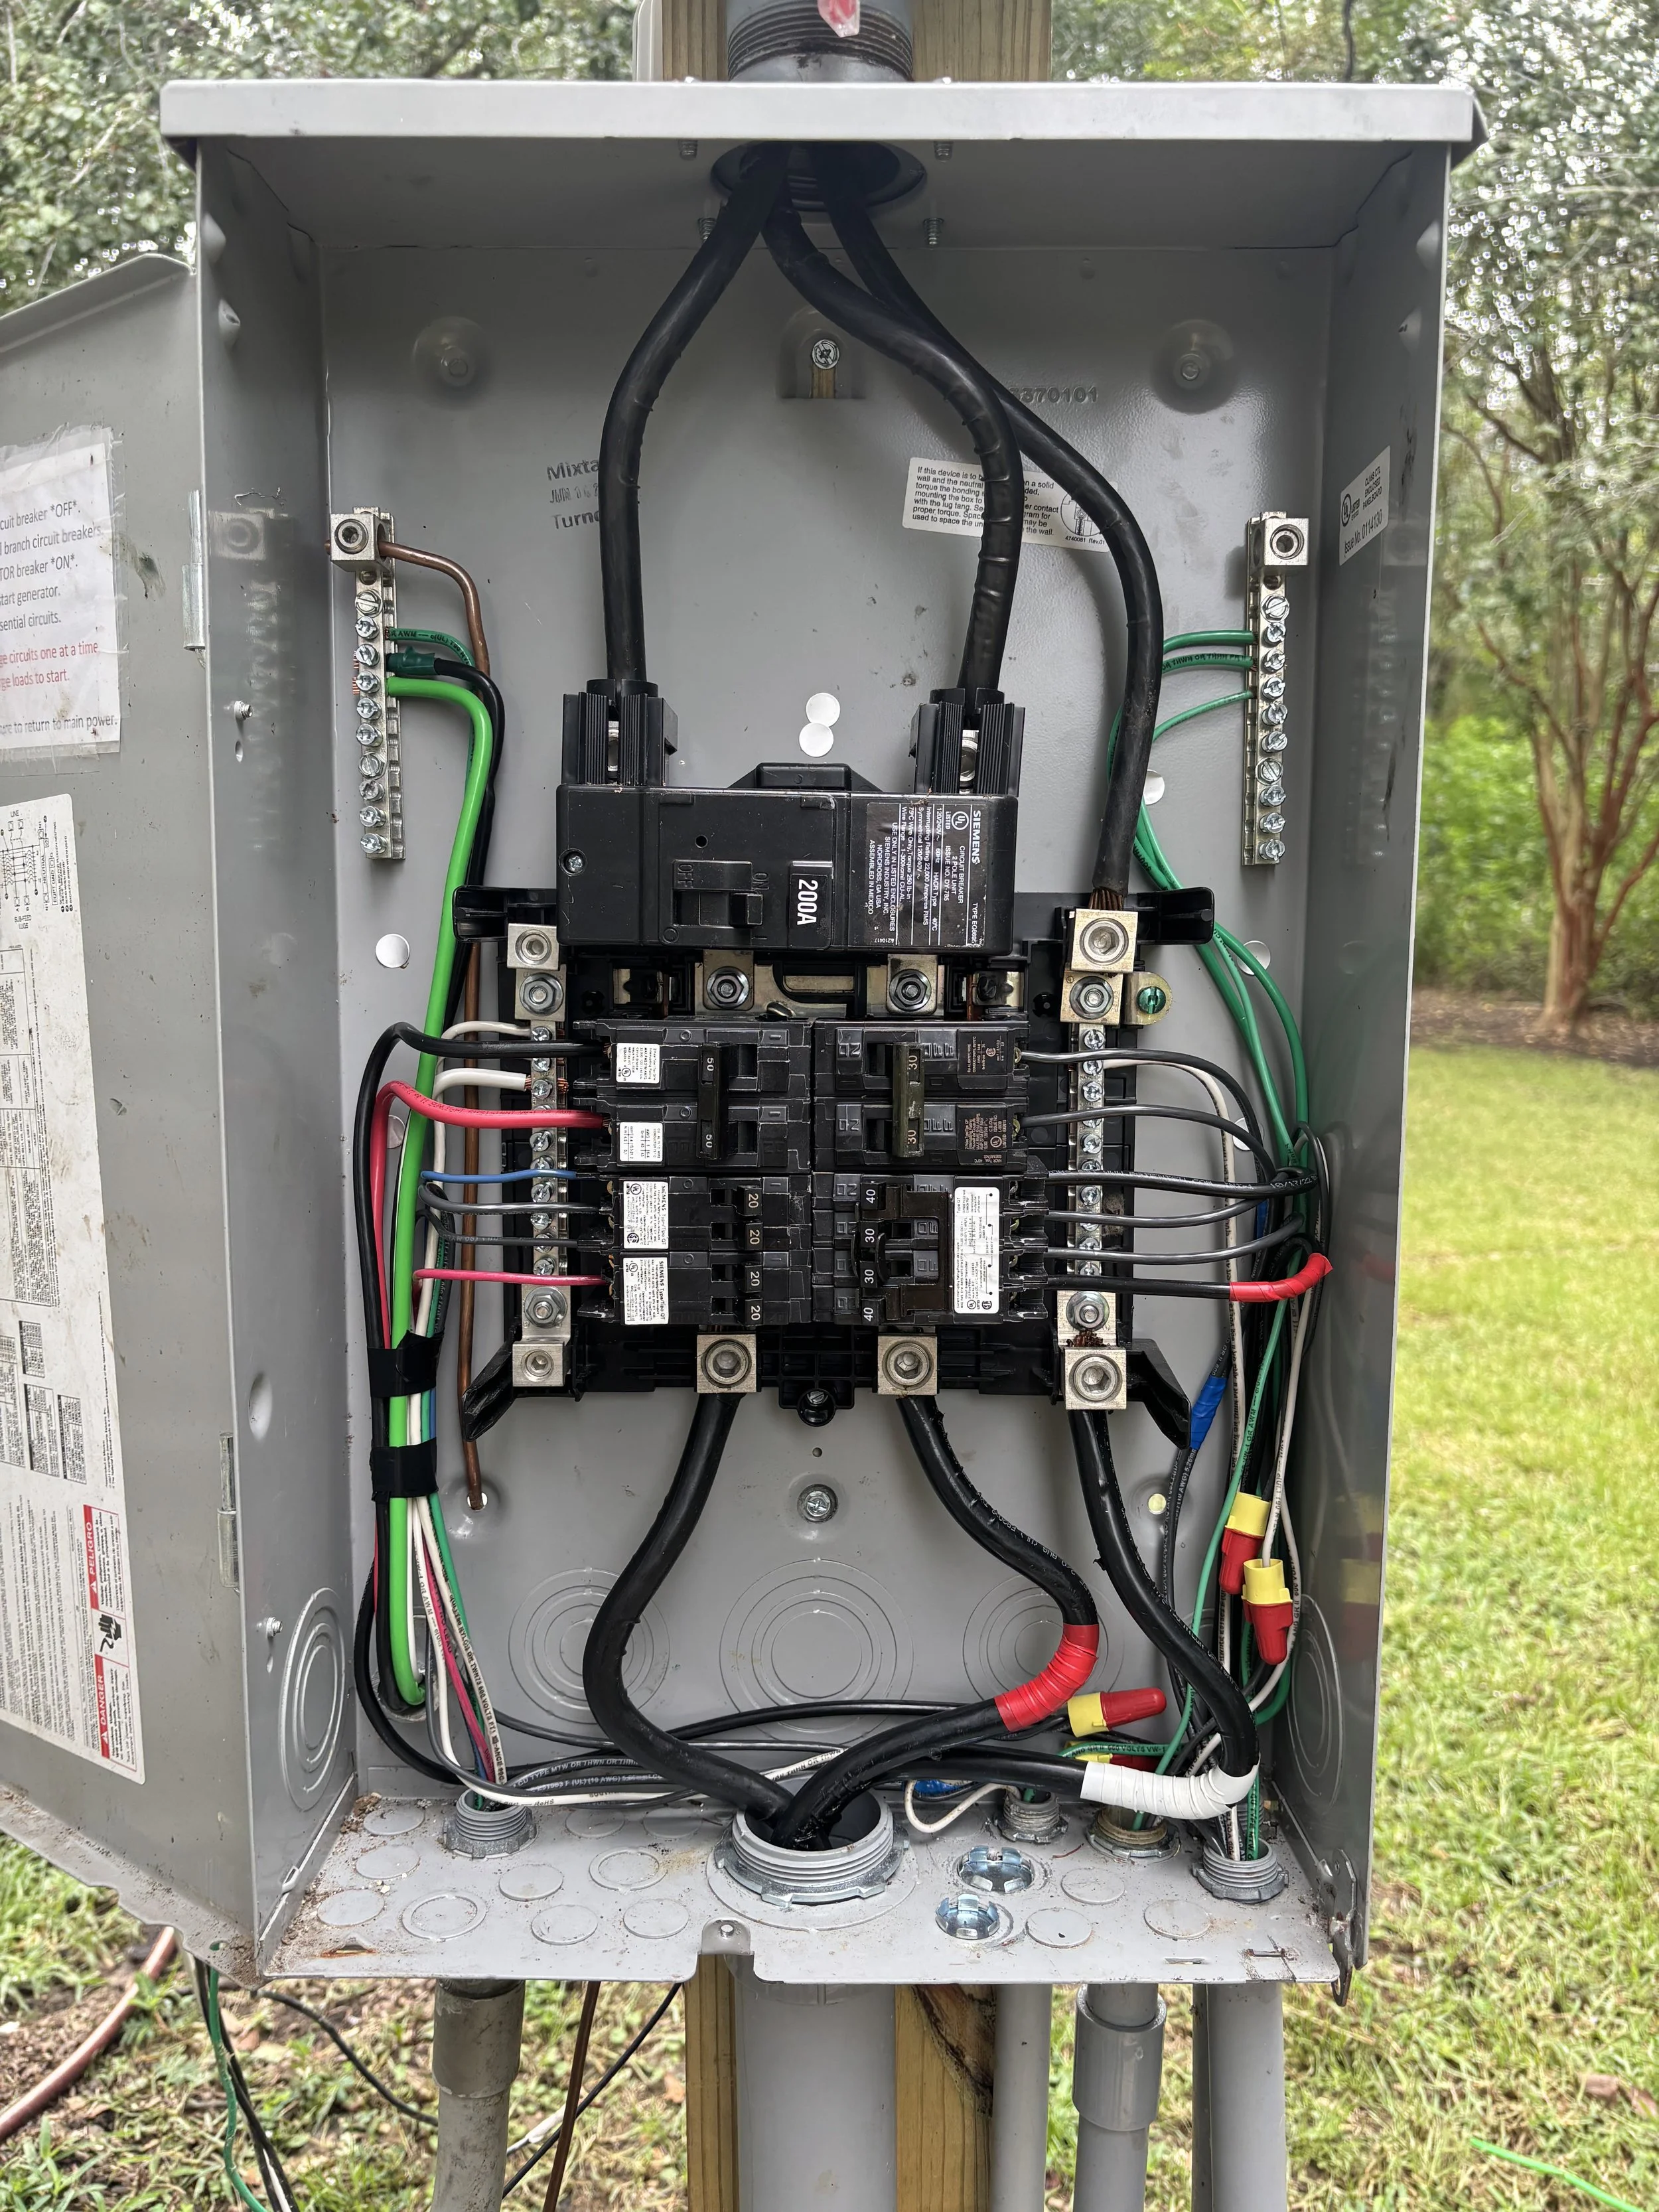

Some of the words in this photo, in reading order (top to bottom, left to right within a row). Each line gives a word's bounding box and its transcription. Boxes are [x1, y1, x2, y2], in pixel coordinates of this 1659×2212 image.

[938, 469, 960, 478] device
[916, 482, 938, 491] torque
[952, 486, 979, 497] bonding
[960, 480, 983, 489] neutral
[915, 491, 946, 500] mounting
[938, 508, 961, 518] torque.
[942, 501, 953, 510] lug
[955, 503, 972, 512] tang.
[1034, 505, 1058, 514] contact
[17, 508, 48, 526] breaker
[1344, 537, 1354, 555] Issue
[1362, 508, 1382, 539] 0114130
[4, 536, 31, 555] branch
[33, 531, 60, 548] circuit
[17, 559, 48, 577] breaker
[17, 586, 60, 606] generator.
[28, 611, 61, 627] circuits.
[9, 648, 38, 664] circuits
[40, 648, 57, 659] one
[59, 644, 68, 658] at
[71, 645, 76, 656] a
[12, 672, 33, 686] loads
[35, 672, 44, 684] to
[46, 669, 70, 683] start.
[25, 720, 50, 733] return
[52, 718, 61, 730] to
[64, 715, 84, 729] main
[87, 715, 117, 731] power.
[954, 816, 965, 826] UL
[972, 810, 981, 863] SIEMENS
[678, 864, 693, 888] OFF
[751, 873, 769, 890] ON
[876, 885, 881, 893] GA
[797, 879, 818, 925] 200A
[707, 1057, 714, 1071] 50
[908, 1055, 918, 1070] 30
[705, 1134, 713, 1148] 50
[908, 1130, 916, 1144] 30
[748, 1193, 759, 1209] 20
[865, 1189, 875, 1204] 40
[749, 1230, 760, 1244] 20
[865, 1228, 875, 1243] 30
[751, 1271, 760, 1286] 20
[864, 1269, 874, 1284] 30
[751, 1305, 760, 1321] 20
[863, 1307, 873, 1322] 40
[1248, 1408, 1257, 1428] AWM
[86, 1522, 95, 1575] PELIGRO
[421, 1595, 434, 1616] AWM
[1293, 1607, 1299, 1618] GR
[98, 1674, 106, 1726] DANGER
[480, 1698, 493, 1720] VOLTS
[808, 1757, 819, 1766] OR
[531, 1769, 549, 1780] TYPE
[551, 1763, 569, 1773] MTW
[571, 1760, 582, 1769] OR
